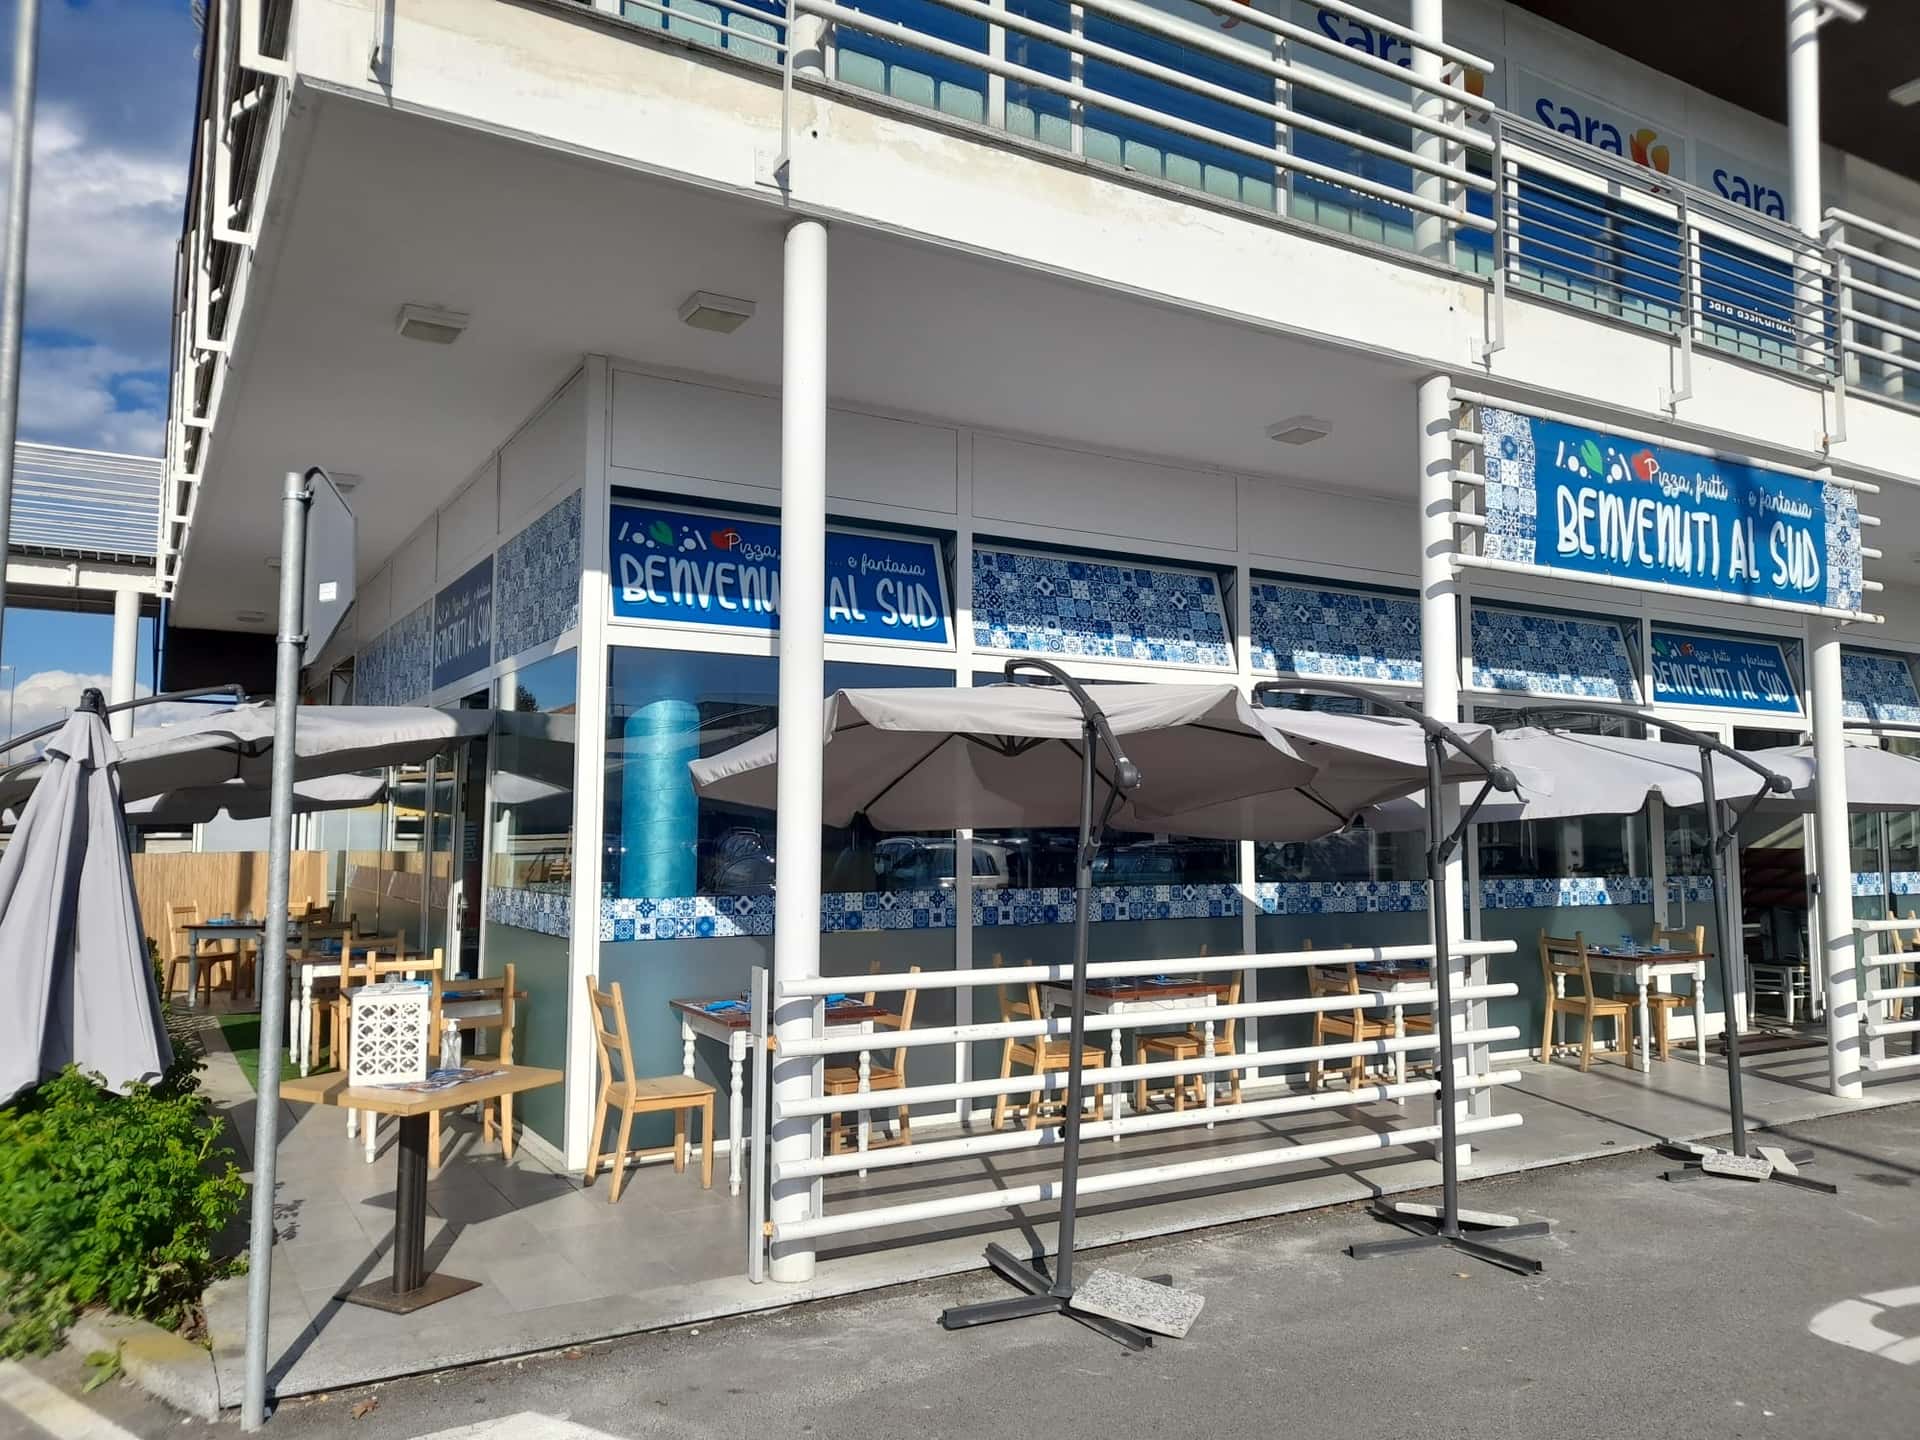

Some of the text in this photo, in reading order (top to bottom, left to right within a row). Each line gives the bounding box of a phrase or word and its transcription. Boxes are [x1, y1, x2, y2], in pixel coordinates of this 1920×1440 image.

[1535, 97, 1623, 156] sara
[1712, 168, 1785, 221] sara
[1759, 486, 1813, 520] fantasia
[861, 552, 926, 578] fantasia
[1555, 484, 1821, 593] BENVENUTI AL SUD
[619, 552, 938, 630] BENVENU AL SUD
[1652, 661, 1790, 704] BENVENUTI AL SUD
